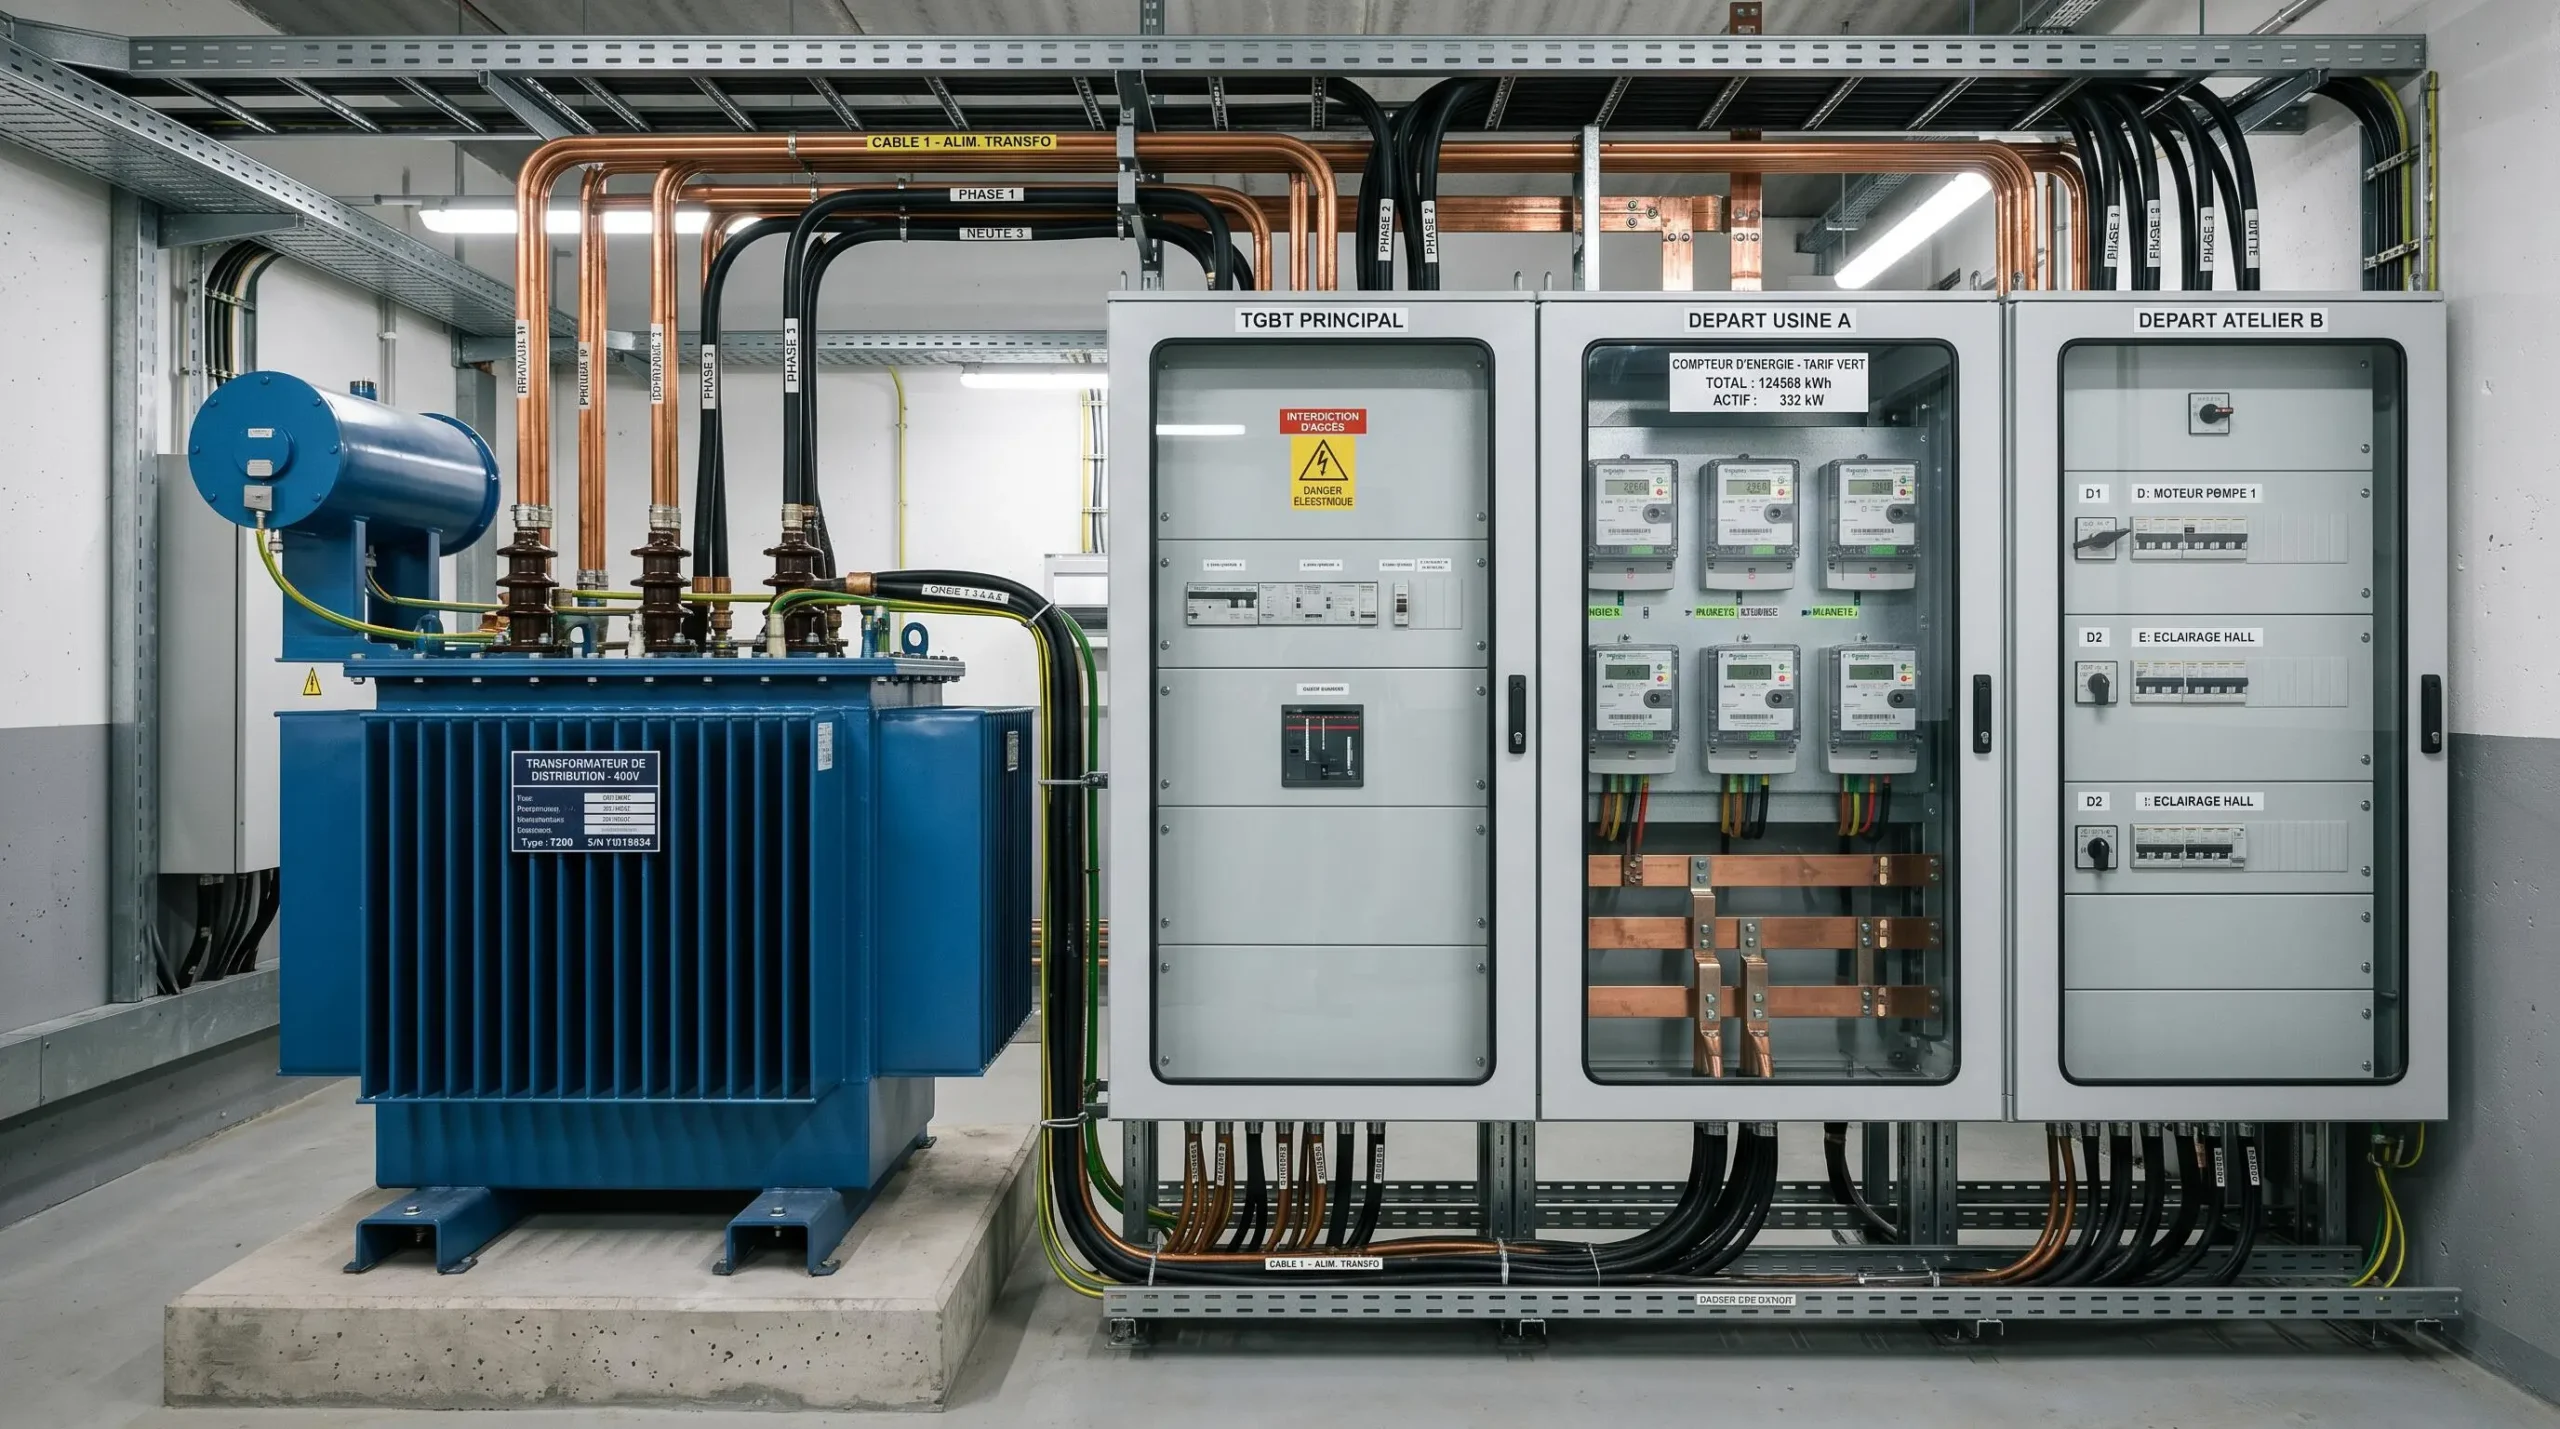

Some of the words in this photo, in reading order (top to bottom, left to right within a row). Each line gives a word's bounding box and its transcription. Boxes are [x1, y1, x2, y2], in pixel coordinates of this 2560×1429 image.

[872, 136, 919, 147] CABLE
[923, 137, 930, 147] 1
[943, 135, 980, 147] ALIM.
[984, 136, 1051, 147] TRANSFO
[959, 189, 1004, 199] PHASE
[1008, 189, 1014, 199] 1
[967, 228, 1011, 238] NEUTE
[1016, 228, 1024, 238] 3
[1425, 218, 1435, 254] PHASE
[1241, 313, 1294, 328] TGBT
[1301, 313, 1403, 328] PRINCIPAL
[1690, 313, 1766, 328] DEPART
[1774, 313, 1831, 328] USINE
[1838, 313, 1851, 328] A
[2140, 313, 2217, 328] DEPART
[2223, 313, 2303, 328] ATELIER
[2311, 313, 2323, 327] B
[786, 339, 797, 382] PHASE
[1673, 359, 1733, 369] COMPTEUR
[1804, 359, 1833, 369] TARIF
[1837, 359, 1865, 369] VERT
[704, 362, 714, 399] PHASE
[1706, 377, 1747, 388] TOTAL
[1759, 377, 1800, 388] 124568
[1805, 377, 1831, 388] kWh
[1780, 394, 1801, 406] 332
[1805, 394, 1825, 406] kW
[1287, 412, 1359, 421] INTERDICTION
[1304, 486, 1342, 494] DANGER
[2086, 489, 2100, 498] D1
[2138, 489, 2149, 498] D:
[2154, 488, 2203, 498] MOTEUR
[2250, 489, 2256, 498] 1
[2087, 632, 2102, 642] D2
[2140, 632, 2150, 642] E:
[2154, 632, 2220, 642] ECLAIRAGE
[2225, 632, 2254, 642] HALL
[526, 759, 628, 769] TRANSFORMATEUR
[632, 759, 645, 768] DE
[532, 771, 604, 781] DISTRIBUTION
[614, 772, 639, 780] 400V
[2087, 796, 2102, 806] D2
[2154, 796, 2220, 806] ECLAIRAGE
[2224, 796, 2253, 806] HALL
[522, 838, 543, 848] Type
[588, 838, 603, 846] S/N
[1269, 1260, 1296, 1268] CABLE
[1300, 1260, 1304, 1268] 1
[1314, 1260, 1338, 1268] ALIM.
[1341, 1260, 1380, 1268] TRANSFO
